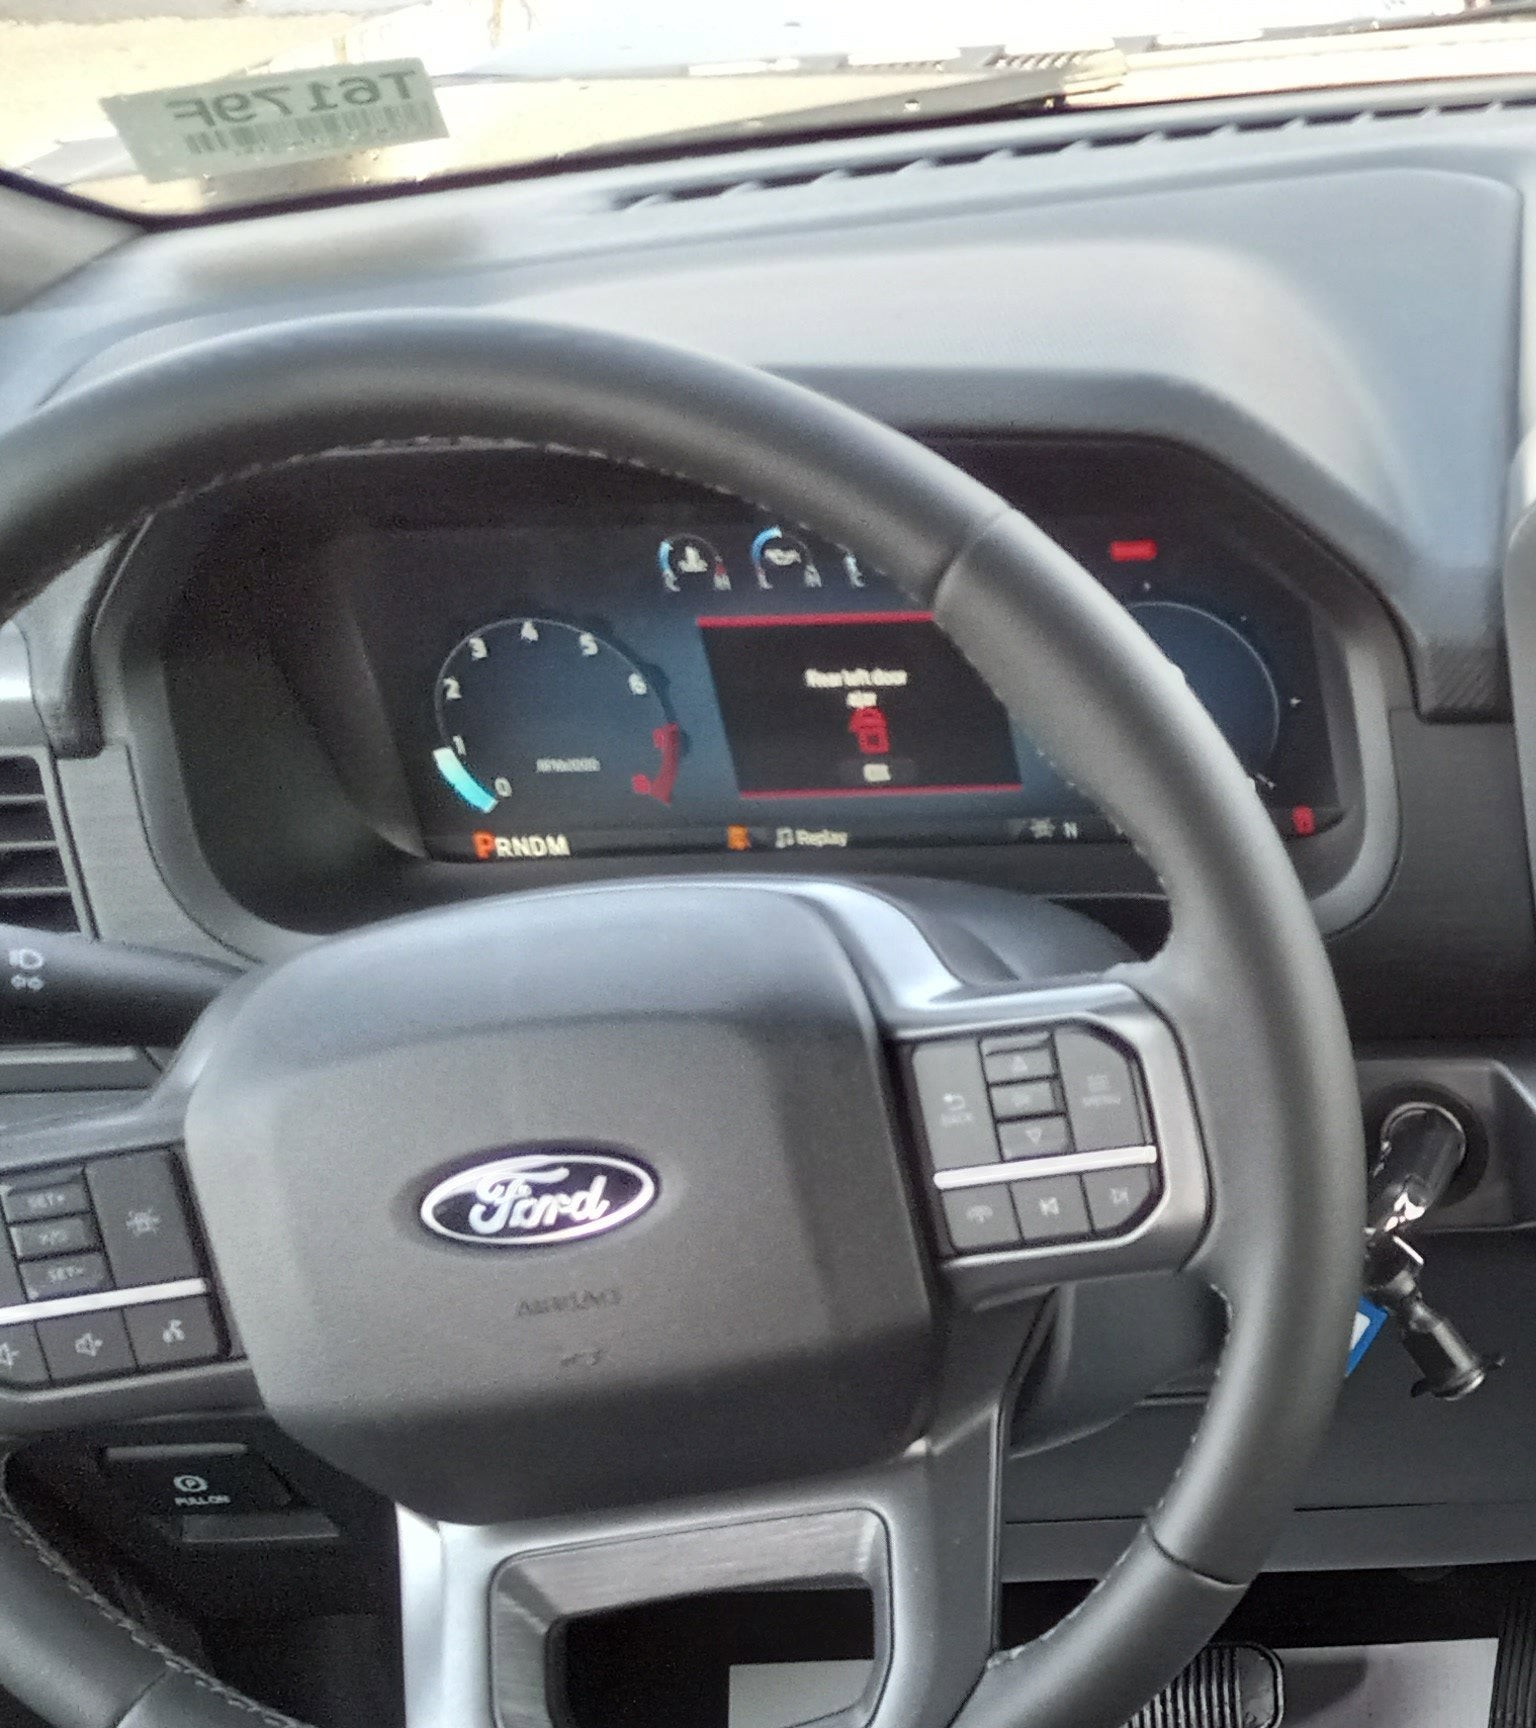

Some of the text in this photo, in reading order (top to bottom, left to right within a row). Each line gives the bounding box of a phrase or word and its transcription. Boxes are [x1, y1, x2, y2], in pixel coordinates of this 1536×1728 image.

[468, 637, 488, 660] 3
[580, 633, 599, 656] 5
[443, 678, 462, 700] 2
[627, 672, 648, 696] 6
[468, 1166, 611, 1235] Ford
